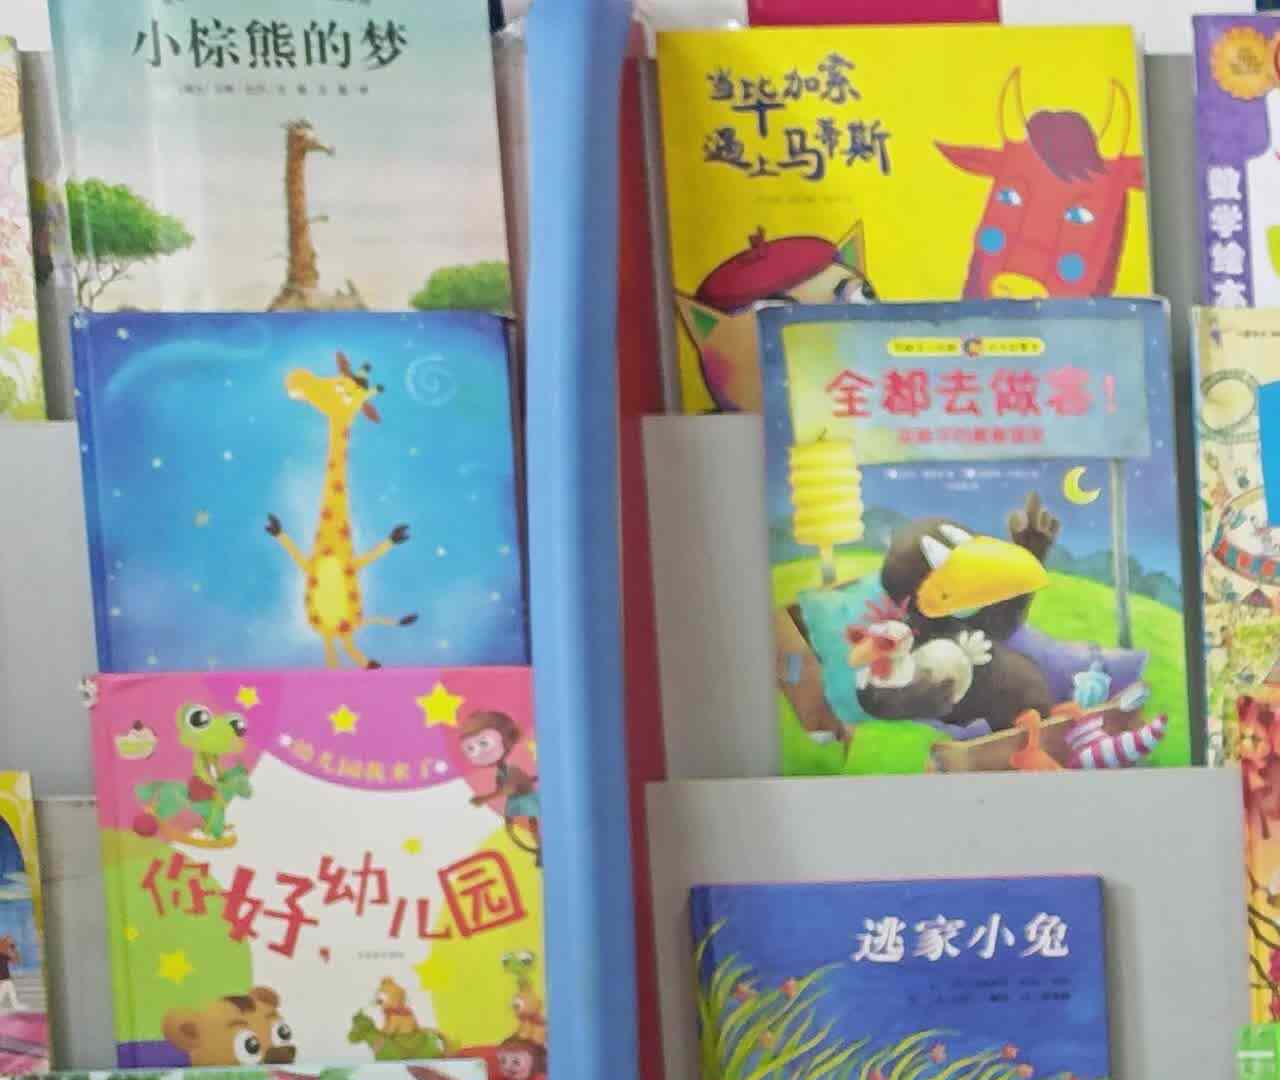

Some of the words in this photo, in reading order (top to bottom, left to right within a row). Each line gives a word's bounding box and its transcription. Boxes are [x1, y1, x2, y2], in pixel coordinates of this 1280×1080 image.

[133, 18, 410, 71] 小棕熊的梦
[705, 53, 861, 137] 当毕加索
[702, 117, 891, 181] 遇上马蒂斯
[851, 911, 1072, 964] 逃家小兔
